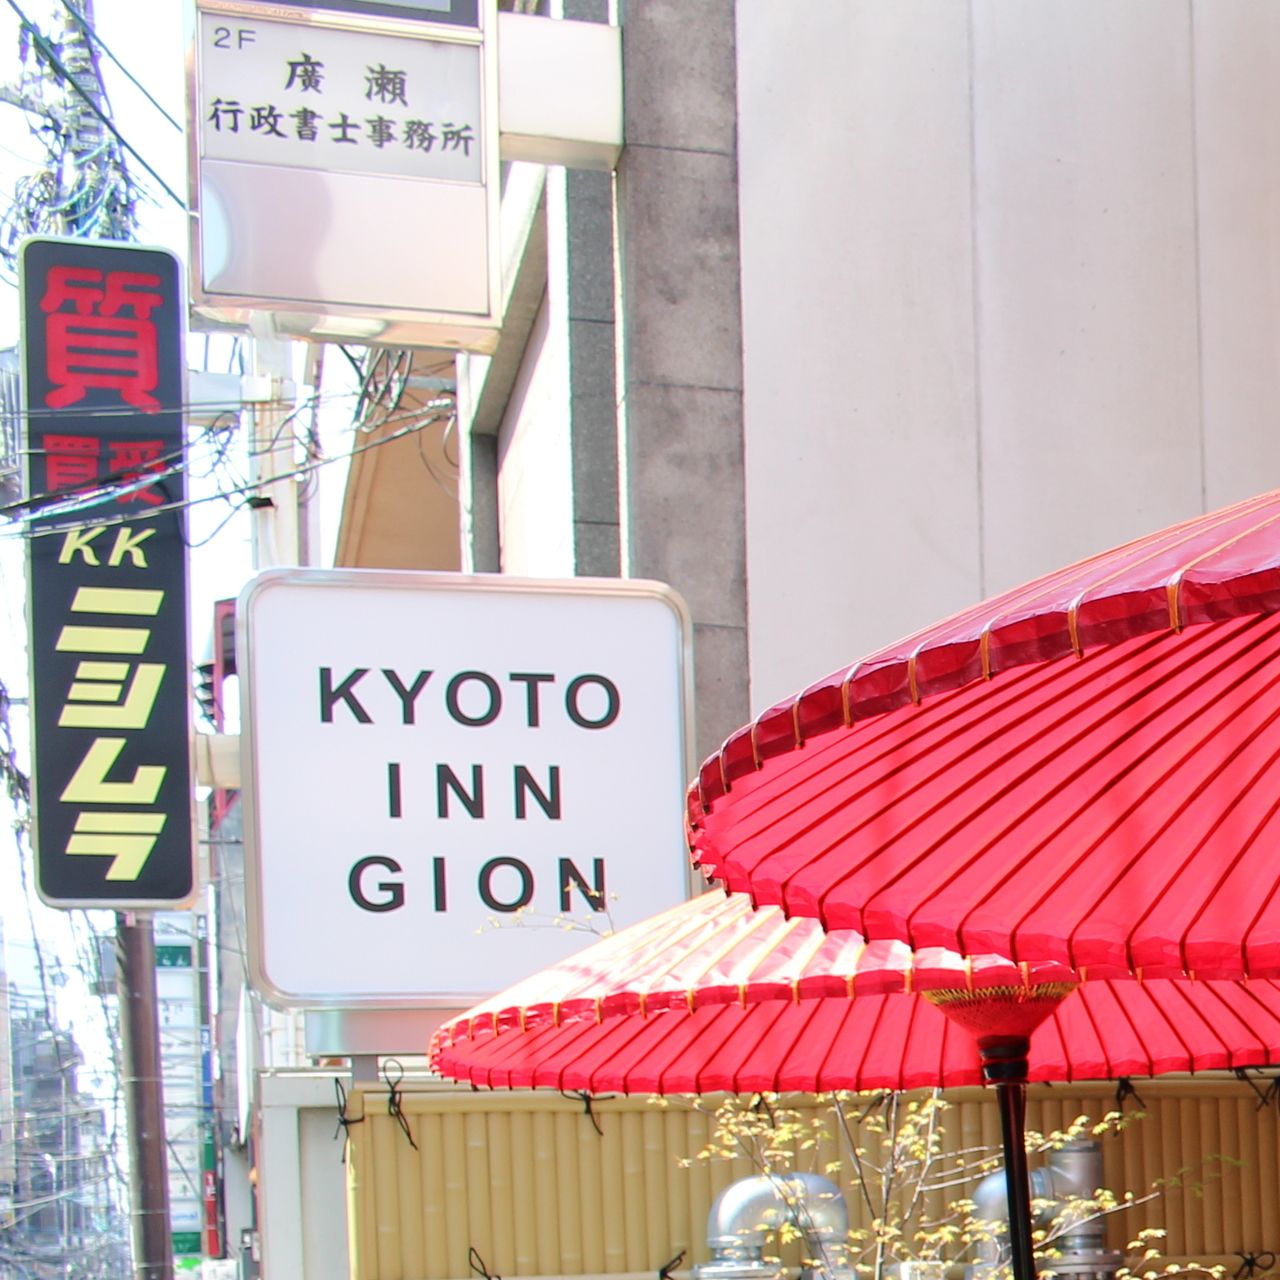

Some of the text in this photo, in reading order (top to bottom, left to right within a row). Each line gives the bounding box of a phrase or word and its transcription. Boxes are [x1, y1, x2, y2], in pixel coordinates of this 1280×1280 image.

[213, 26, 257, 50] 2F
[206, 97, 476, 157] 行政書士事務所
[40, 264, 164, 415] 質
[57, 525, 157, 569] KK
[318, 666, 622, 730] KYOTO
[54, 586, 168, 882] ニシムラ
[387, 762, 563, 821] INN
[347, 855, 606, 914] GION
